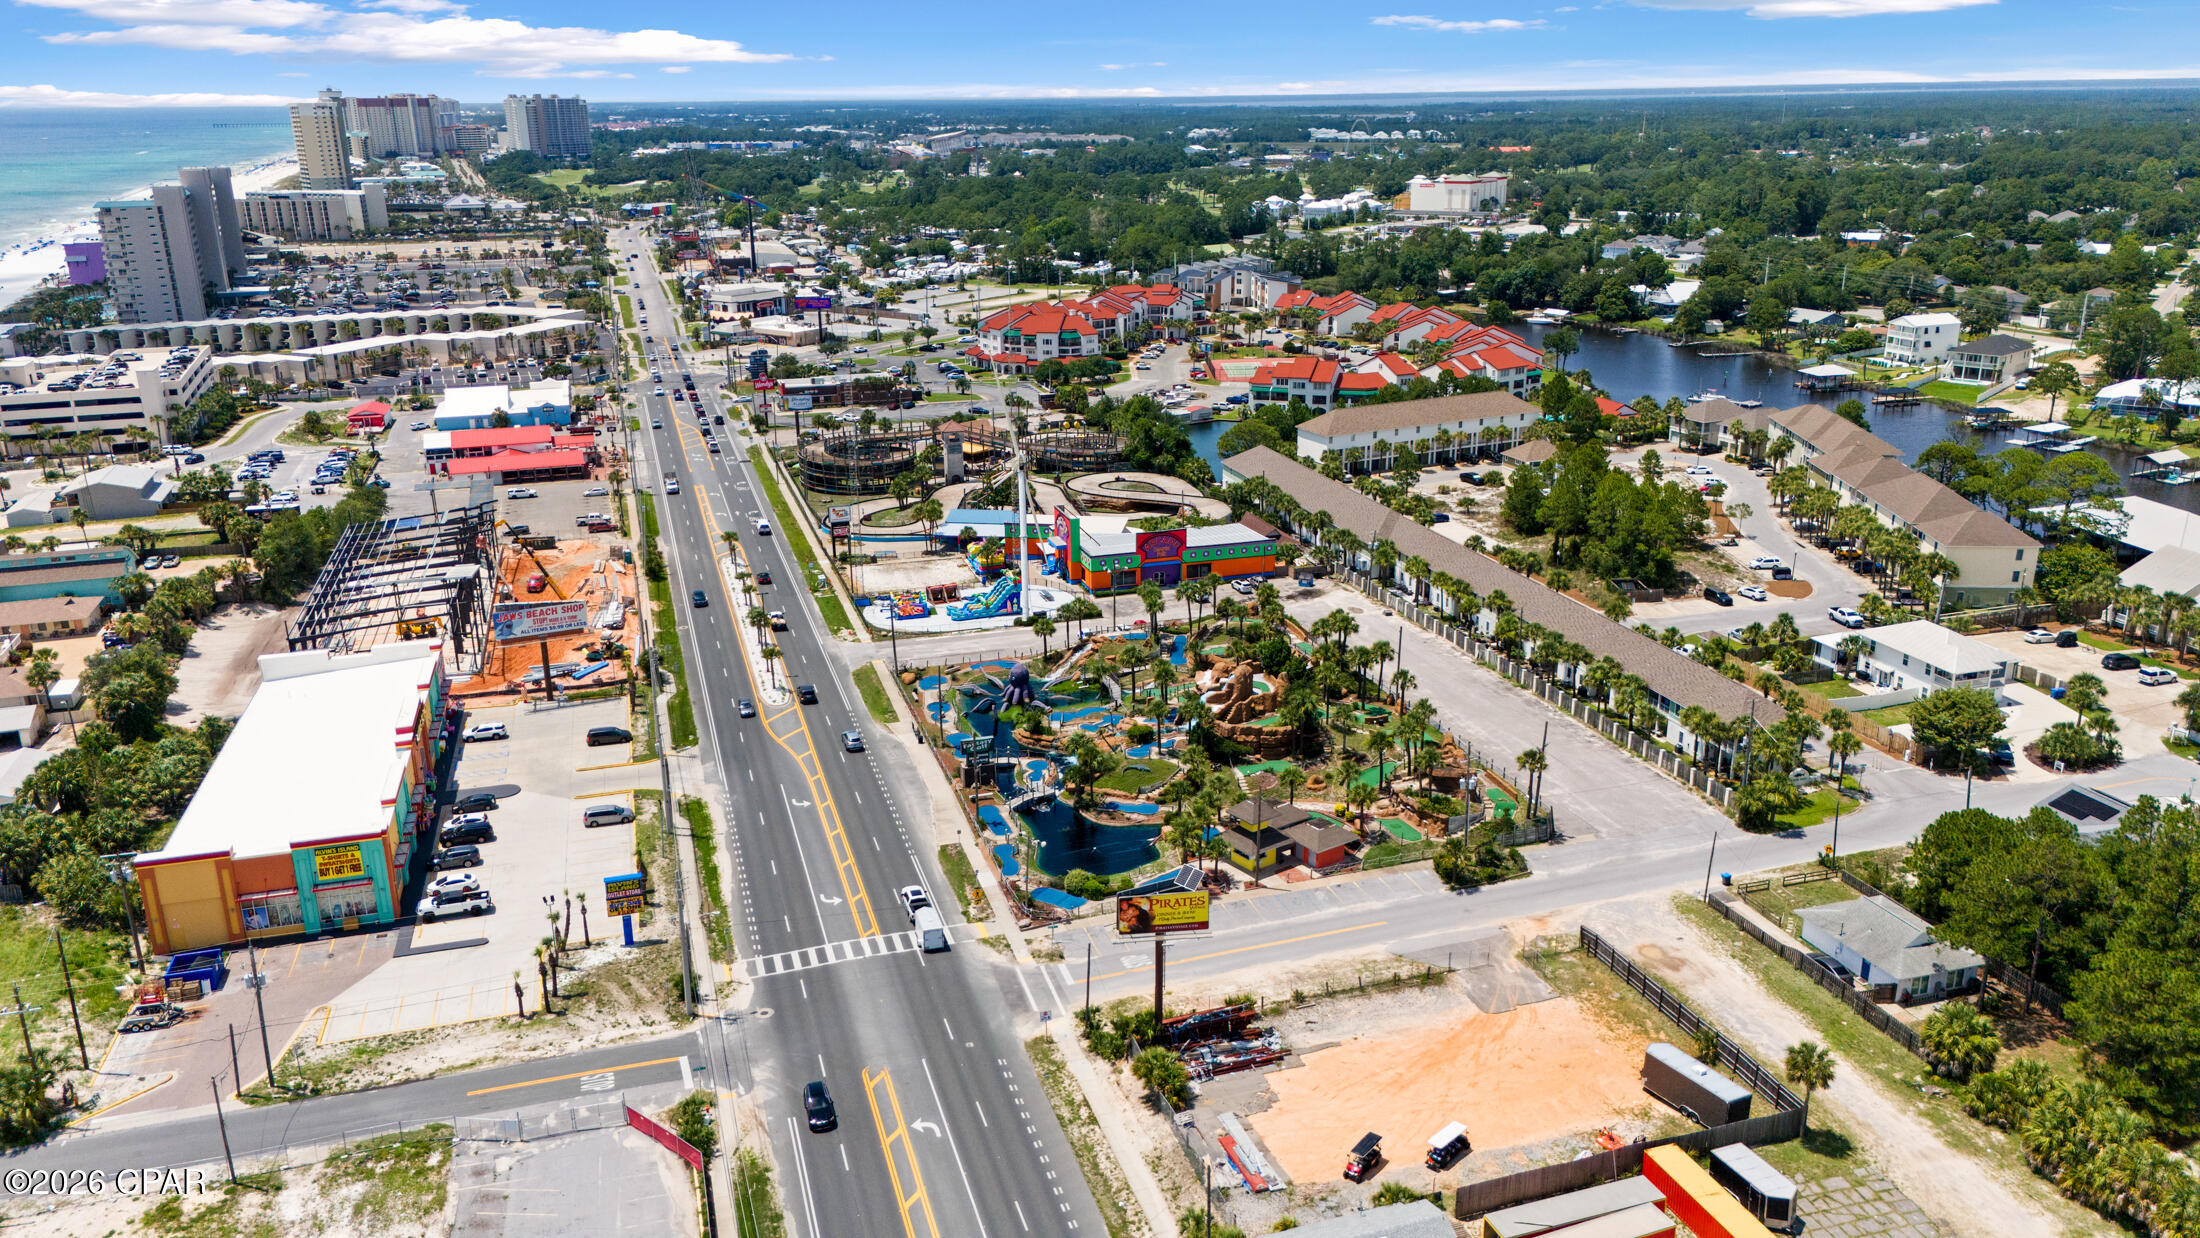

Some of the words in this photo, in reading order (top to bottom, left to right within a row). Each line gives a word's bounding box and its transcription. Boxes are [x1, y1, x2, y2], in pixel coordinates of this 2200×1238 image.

[497, 612, 523, 622] JAWS
[526, 608, 558, 619] BEACH
[561, 603, 584, 614] SHOP
[315, 847, 337, 856] ALVIN'S
[337, 845, 359, 853] ISLAND
[319, 867, 330, 877] BUY
[335, 865, 345, 875] GET
[349, 863, 362, 873] FREE
[1149, 896, 1206, 911] PIRATES
